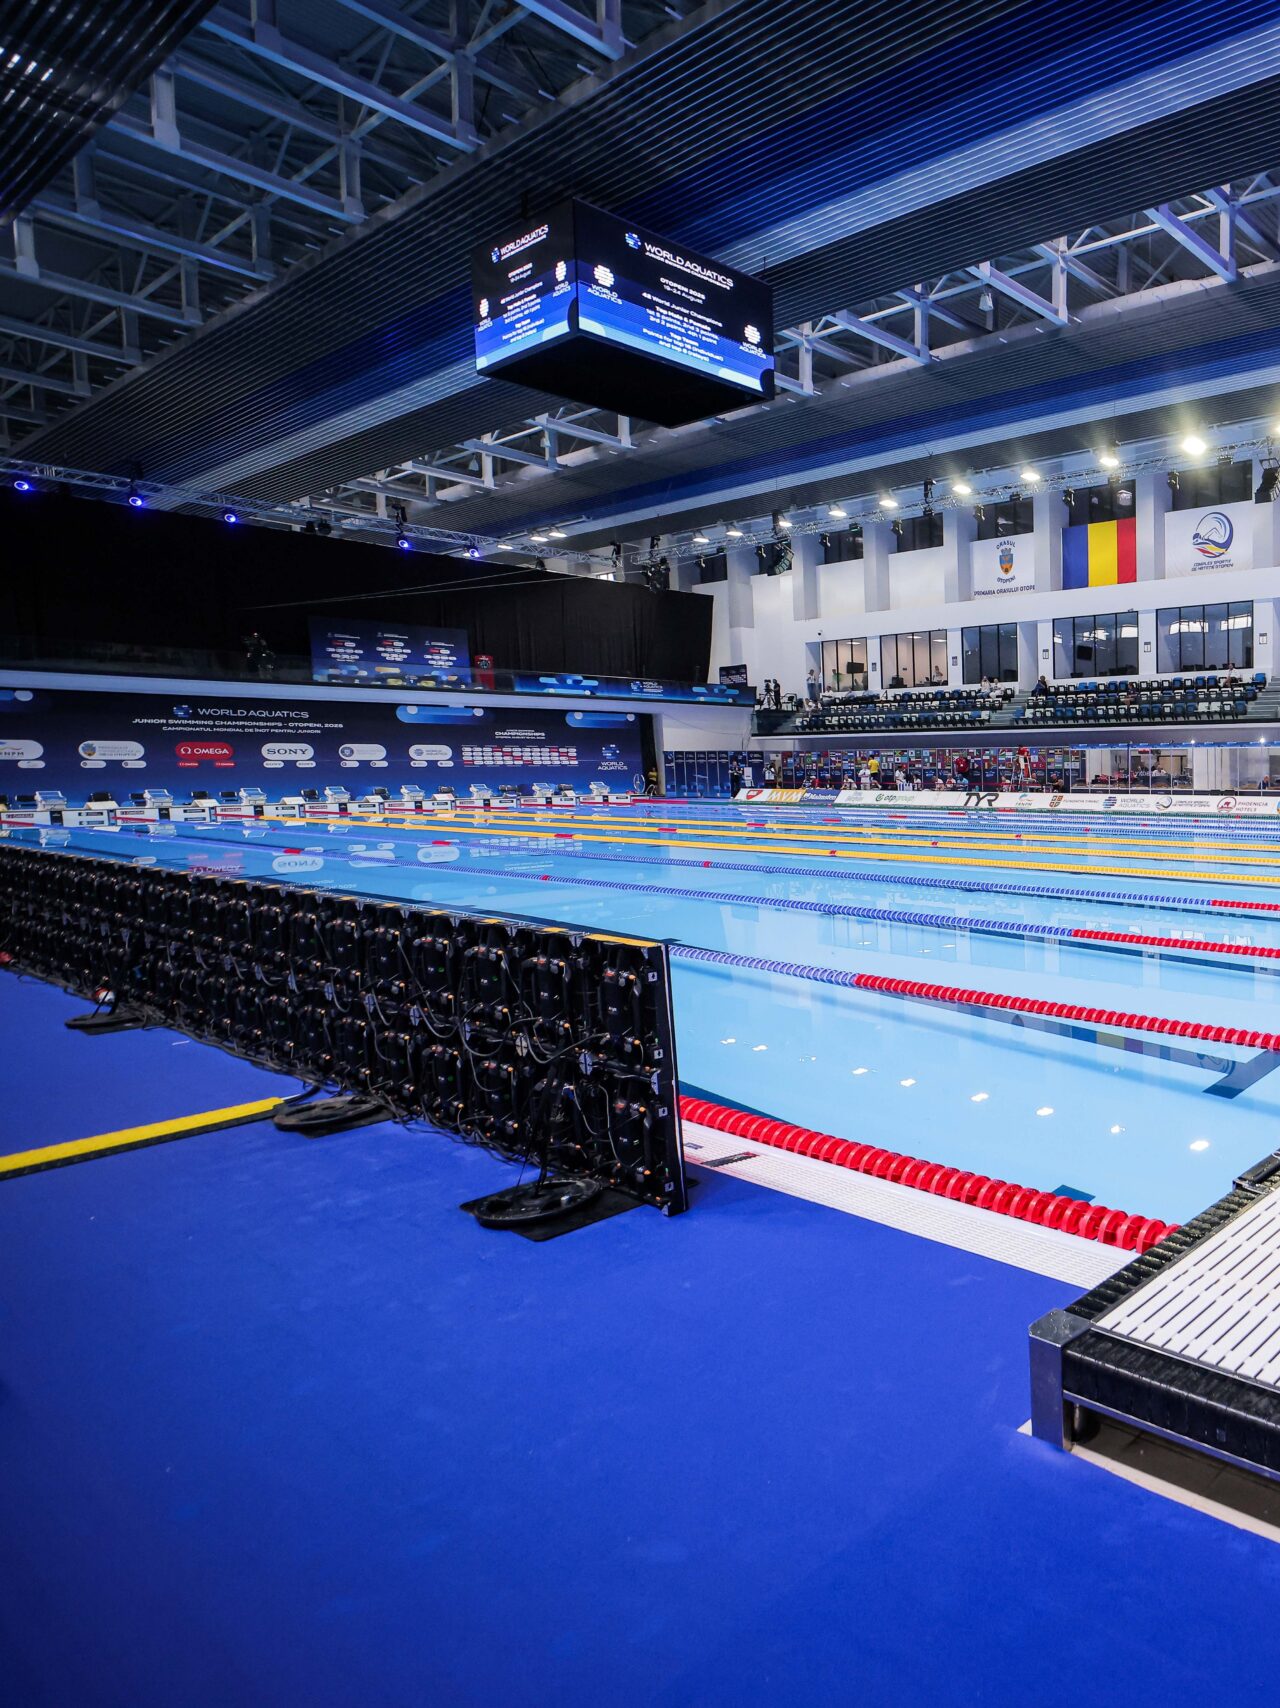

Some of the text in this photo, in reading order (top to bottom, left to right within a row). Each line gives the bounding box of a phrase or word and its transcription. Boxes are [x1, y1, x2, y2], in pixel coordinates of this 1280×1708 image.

[500, 240, 520, 255] WORLD
[520, 224, 548, 245] AQUATICS
[644, 242, 733, 287] WORLD AQUATICS
[591, 284, 618, 298] WORLD
[660, 278, 688, 292] OTOPENI
[587, 288, 622, 305] AQUATICS
[682, 292, 703, 304] August
[652, 296, 670, 306] World
[672, 304, 690, 314] Junior
[690, 311, 722, 327] Champions
[996, 540, 1016, 549] ORASUL
[197, 708, 309, 718] WORLD AQUATICS
[770, 791, 800, 800] MVM
[964, 792, 999, 806] TYR
